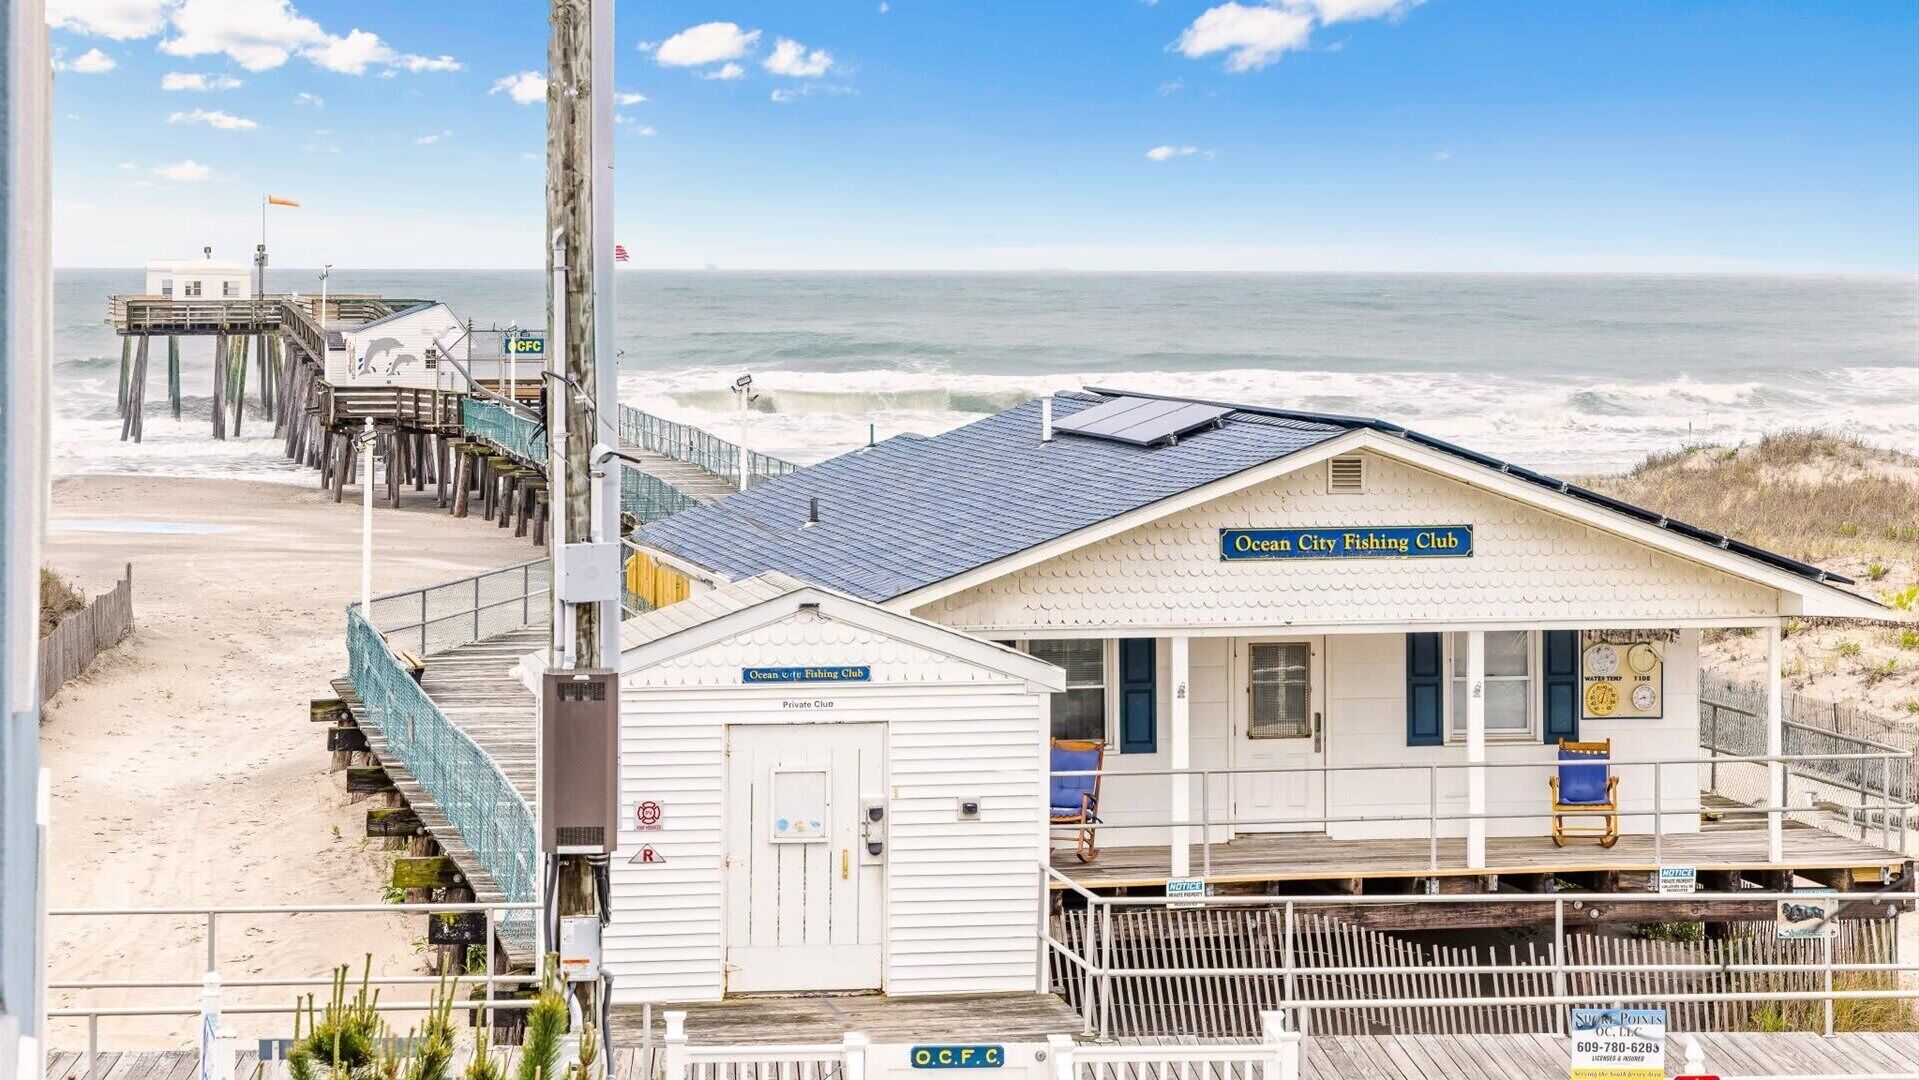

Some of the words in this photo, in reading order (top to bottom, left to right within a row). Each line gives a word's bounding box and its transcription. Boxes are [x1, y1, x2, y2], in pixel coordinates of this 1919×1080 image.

[1235, 535, 1291, 551] Ocean
[1298, 534, 1336, 553] City
[1343, 533, 1408, 552] Fishing
[1416, 532, 1459, 549] Club
[749, 669, 778, 680] Ocean
[805, 669, 838, 680] Fishing
[841, 668, 863, 678] Club
[782, 701, 811, 709] Private
[814, 700, 834, 709] Club
[643, 849, 653, 862] R
[1662, 869, 1693, 877] NOTICE
[1169, 882, 1202, 891] NOTICE
[1619, 1027, 1642, 1037] LLC
